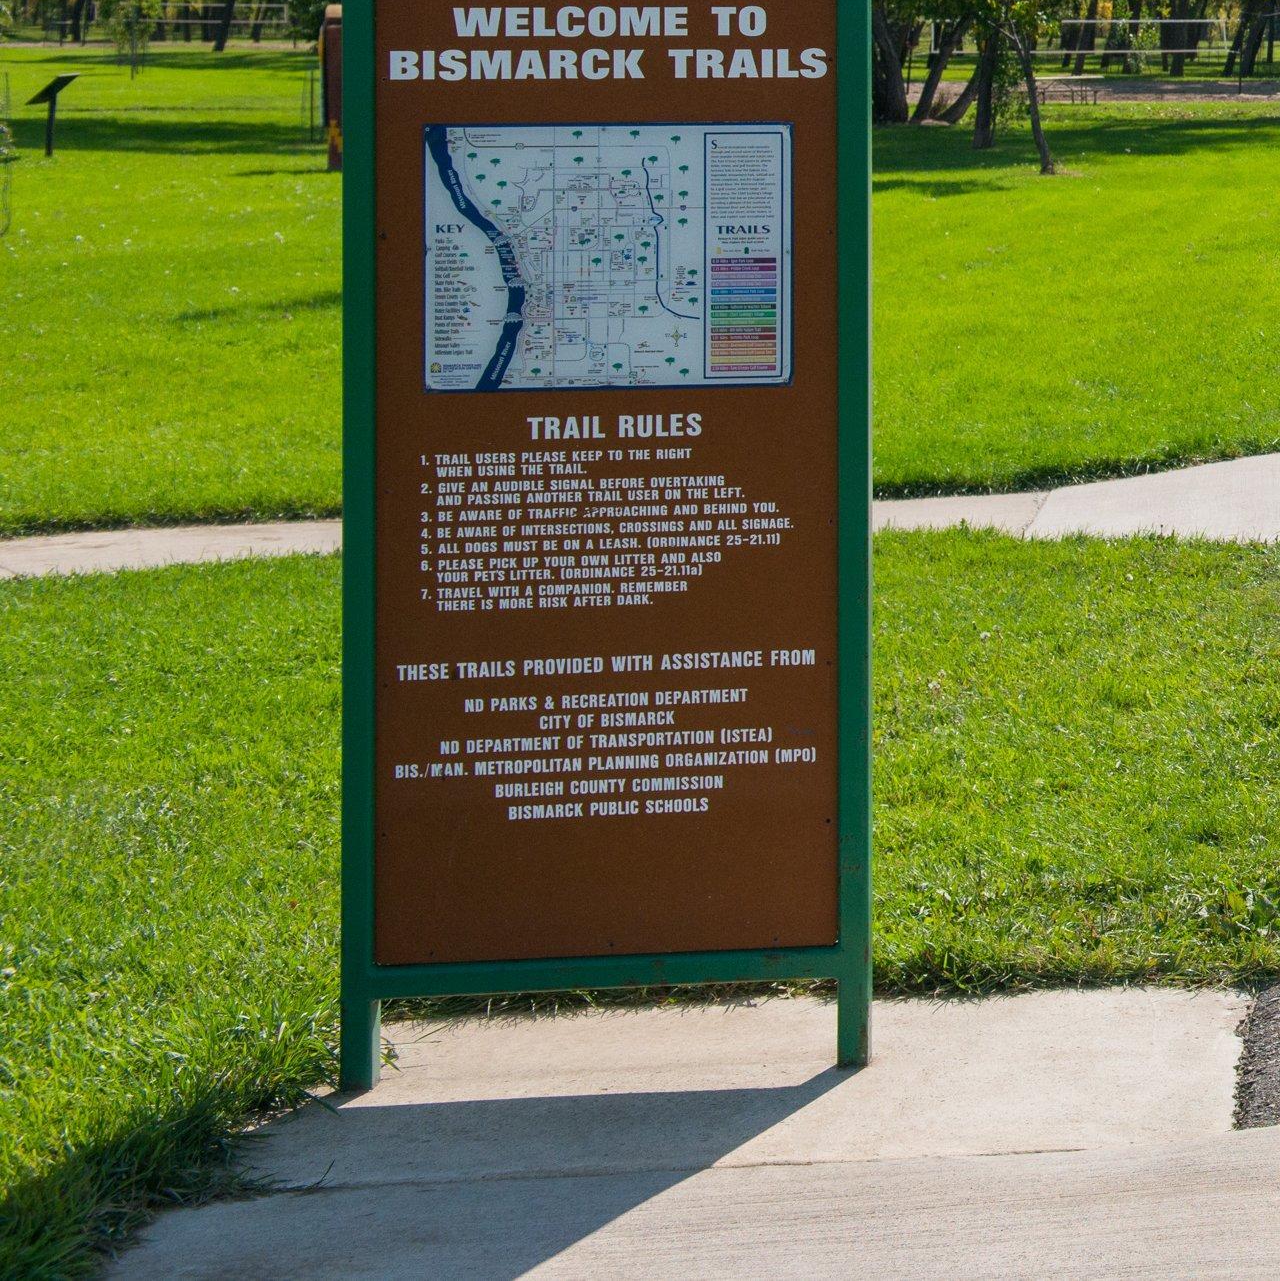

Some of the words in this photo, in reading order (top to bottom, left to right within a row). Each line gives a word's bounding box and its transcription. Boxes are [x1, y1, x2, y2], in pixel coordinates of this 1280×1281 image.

[453, 6, 688, 36] WELCOME
[711, 6, 766, 36] TO
[389, 49, 643, 79] BISMARCK
[667, 48, 827, 78] TRAILS
[435, 224, 465, 234] KEY
[716, 225, 770, 234] TRAILS
[526, 416, 605, 439] TRAIL
[618, 413, 701, 437] RULES
[420, 454, 429, 465] 1.
[434, 454, 470, 464] TRAIL
[475, 452, 515, 463] USERS
[521, 451, 566, 462] PLEASE
[572, 450, 602, 461] KEEP
[607, 449, 622, 460] TO
[627, 449, 650, 460] THE
[656, 448, 691, 459] RIGHT
[436, 466, 472, 477] WHEN
[477, 464, 515, 476] USING
[520, 464, 543, 475] THE
[548, 463, 586, 474] TRAIL.
[420, 483, 432, 493] 2.
[438, 482, 465, 493] GIVE
[471, 481, 487, 492] AN
[493, 480, 544, 491] AUDIBLE
[549, 479, 594, 490] SIGNAL
[599, 477, 644, 488] BEFORE
[650, 475, 724, 487] OVERTAKING
[436, 494, 461, 505] AND
[467, 493, 520, 504] PASSING
[526, 491, 582, 503] ANOTHER
[587, 490, 622, 501] TRAIL
[627, 489, 658, 500] USER
[664, 488, 680, 499] ON
[686, 488, 708, 498] THE
[714, 487, 744, 498] LEFT.
[420, 511, 432, 522] 3.
[437, 511, 452, 521] BE
[458, 509, 502, 521] AWARE
[507, 508, 522, 519] OF
[527, 507, 577, 518] TRAFFIC
[582, 505, 667, 517] APPROACHING
[673, 504, 698, 515] AND
[703, 503, 747, 514] BEHIND
[753, 502, 779, 512] YOU.
[420, 528, 431, 538] 4.
[437, 527, 451, 538] BE
[456, 526, 496, 537] AWARE
[502, 525, 515, 536] OF
[521, 523, 614, 535] INTERSECTIONS,
[619, 521, 684, 532] CROSSINGS
[689, 520, 712, 531] AND
[717, 519, 737, 530] ALL
[741, 518, 793, 529] SIGNAGE.
[420, 544, 431, 554] 5.
[438, 543, 459, 553] ALL
[464, 541, 497, 552] DOGS
[503, 540, 537, 551] MUST
[542, 540, 557, 550] BE
[563, 539, 579, 550] ON
[585, 539, 593, 549] A
[599, 537, 641, 549] LEASH.
[647, 535, 720, 547] (ORDINANCE
[726, 533, 780, 545] 25-21.11)
[420, 560, 432, 571] 6.
[438, 558, 483, 570] PLEASE
[489, 557, 516, 568] PICK
[522, 557, 538, 567] UP
[543, 556, 575, 567] YOUR
[580, 555, 608, 566] OWN
[614, 553, 654, 565] LITTER
[660, 552, 685, 564] AND
[690, 552, 721, 565] ALSO
[436, 571, 468, 582] YOUR
[474, 570, 505, 581] PET'S
[509, 569, 554, 580] LITTER.
[560, 566, 634, 579] (ORDINANCE
[640, 565, 702, 576] 25-21.11a)
[421, 588, 431, 599] 7.
[436, 587, 482, 598] TRAVEL
[488, 586, 519, 597] WITH
[524, 585, 532, 596] A
[538, 583, 614, 595] COMPANION.
[620, 581, 687, 592] REMEMBER
[436, 599, 474, 611] THERE
[481, 599, 493, 609] IS
[498, 597, 533, 609] MORE
[538, 596, 567, 607] RISK
[573, 595, 611, 606] AFTER
[616, 594, 653, 605] DARK.
[396, 663, 449, 680] THESE
[456, 660, 515, 678] TRAILS
[523, 657, 603, 675] PROVIDED
[611, 655, 652, 671] WITH
[660, 651, 762, 669] ASSISTANCE
[770, 649, 815, 665] FROM
[464, 698, 483, 712] ND
[490, 696, 537, 711] PARKS
[544, 695, 554, 709] &
[561, 692, 648, 708] RECREATION
[655, 688, 747, 704] DEPARTMENT
[539, 715, 570, 729] CITY
[577, 713, 593, 728] OF
[600, 711, 674, 726] BISMARCK
[440, 740, 459, 754] ND
[466, 736, 560, 752] DEPARTMENT
[566, 735, 583, 749] OF
[589, 730, 714, 747] TRANSPORTATION
[720, 727, 772, 743] (ISTEA)
[474, 758, 581, 775] METROPOLITAN
[588, 754, 658, 770] PLANNING
[665, 750, 768, 766] ORGANIZATION
[775, 748, 816, 763] (MPO)
[495, 781, 563, 797] BURLEIGH
[570, 779, 625, 794] COUNTY
[632, 775, 723, 791] COMMISSION
[508, 803, 582, 819] BISMARCK
[590, 801, 638, 815] PUBLIC
[645, 798, 708, 813] SCHOOLS
